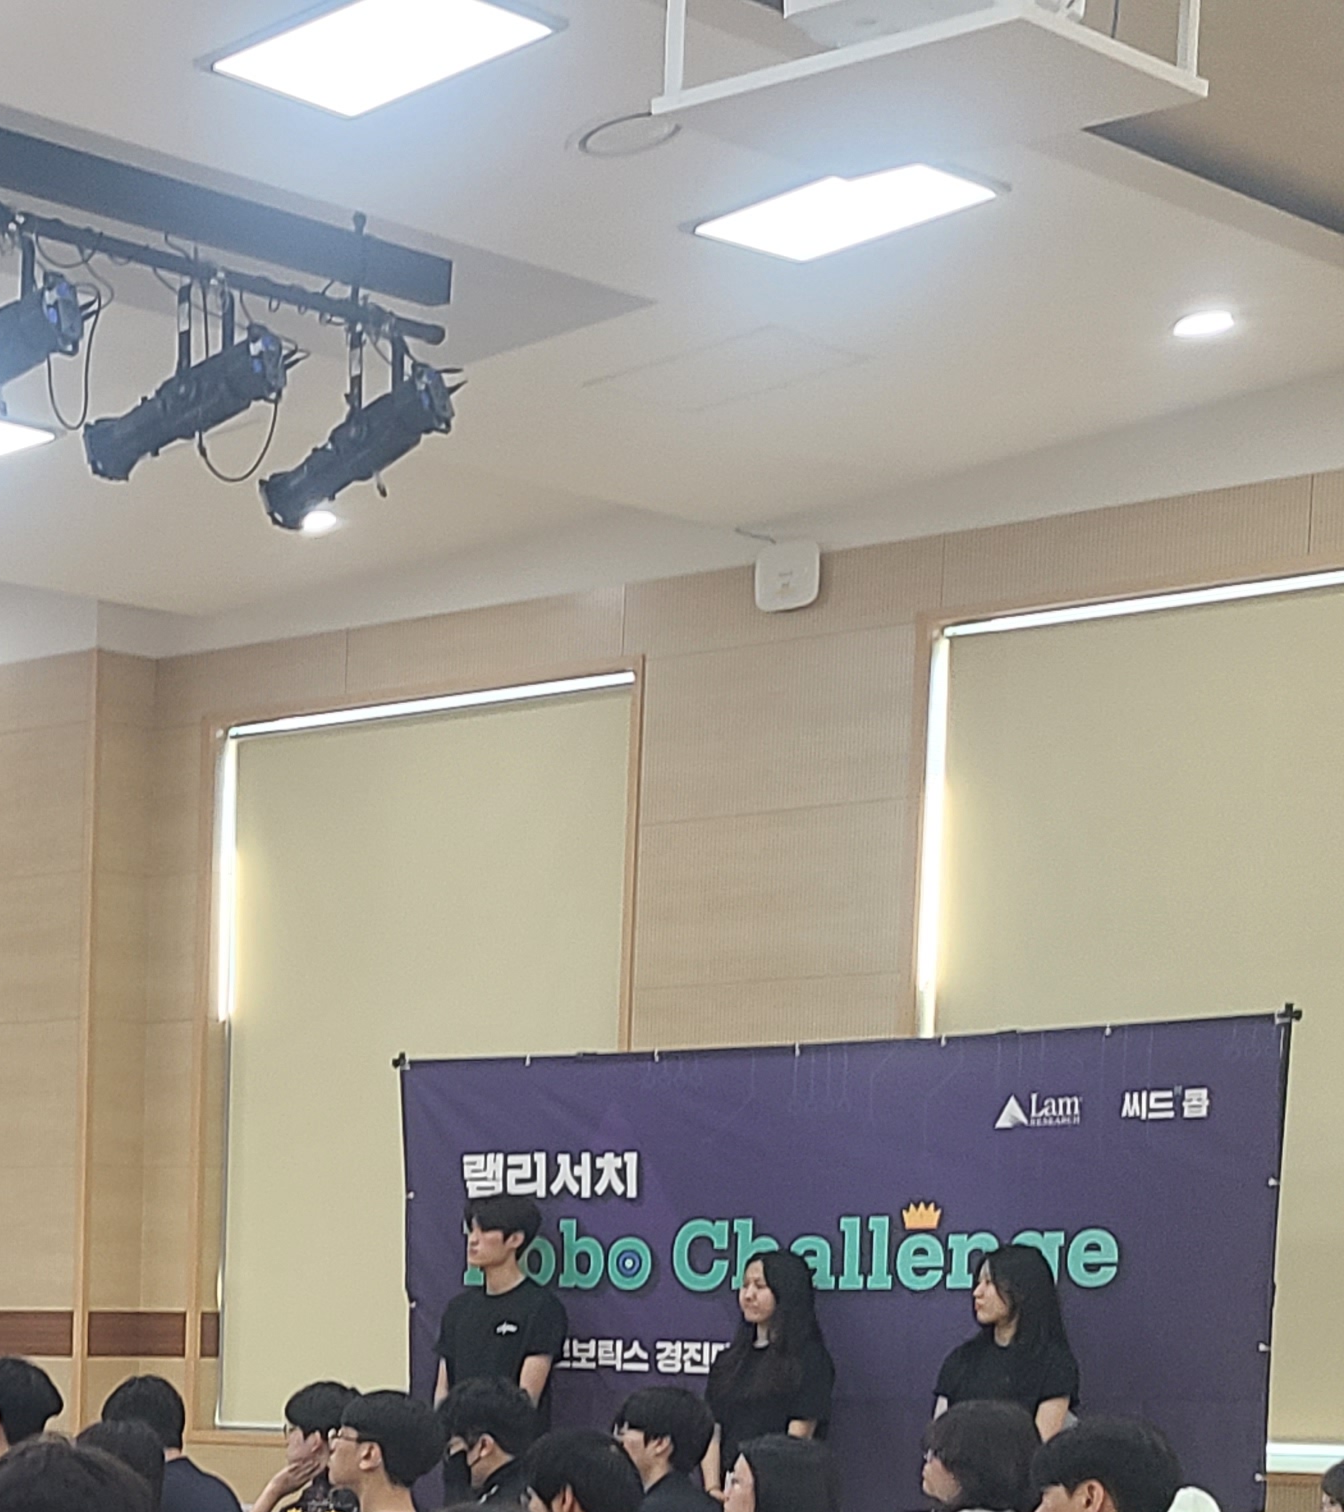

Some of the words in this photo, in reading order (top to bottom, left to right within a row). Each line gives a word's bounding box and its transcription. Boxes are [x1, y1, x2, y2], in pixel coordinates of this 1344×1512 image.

[1030, 1091, 1081, 1117] Lam
[462, 1151, 639, 1199] 램리서치
[463, 1218, 652, 1290] obo
[655, 1339, 731, 1374] 경진
